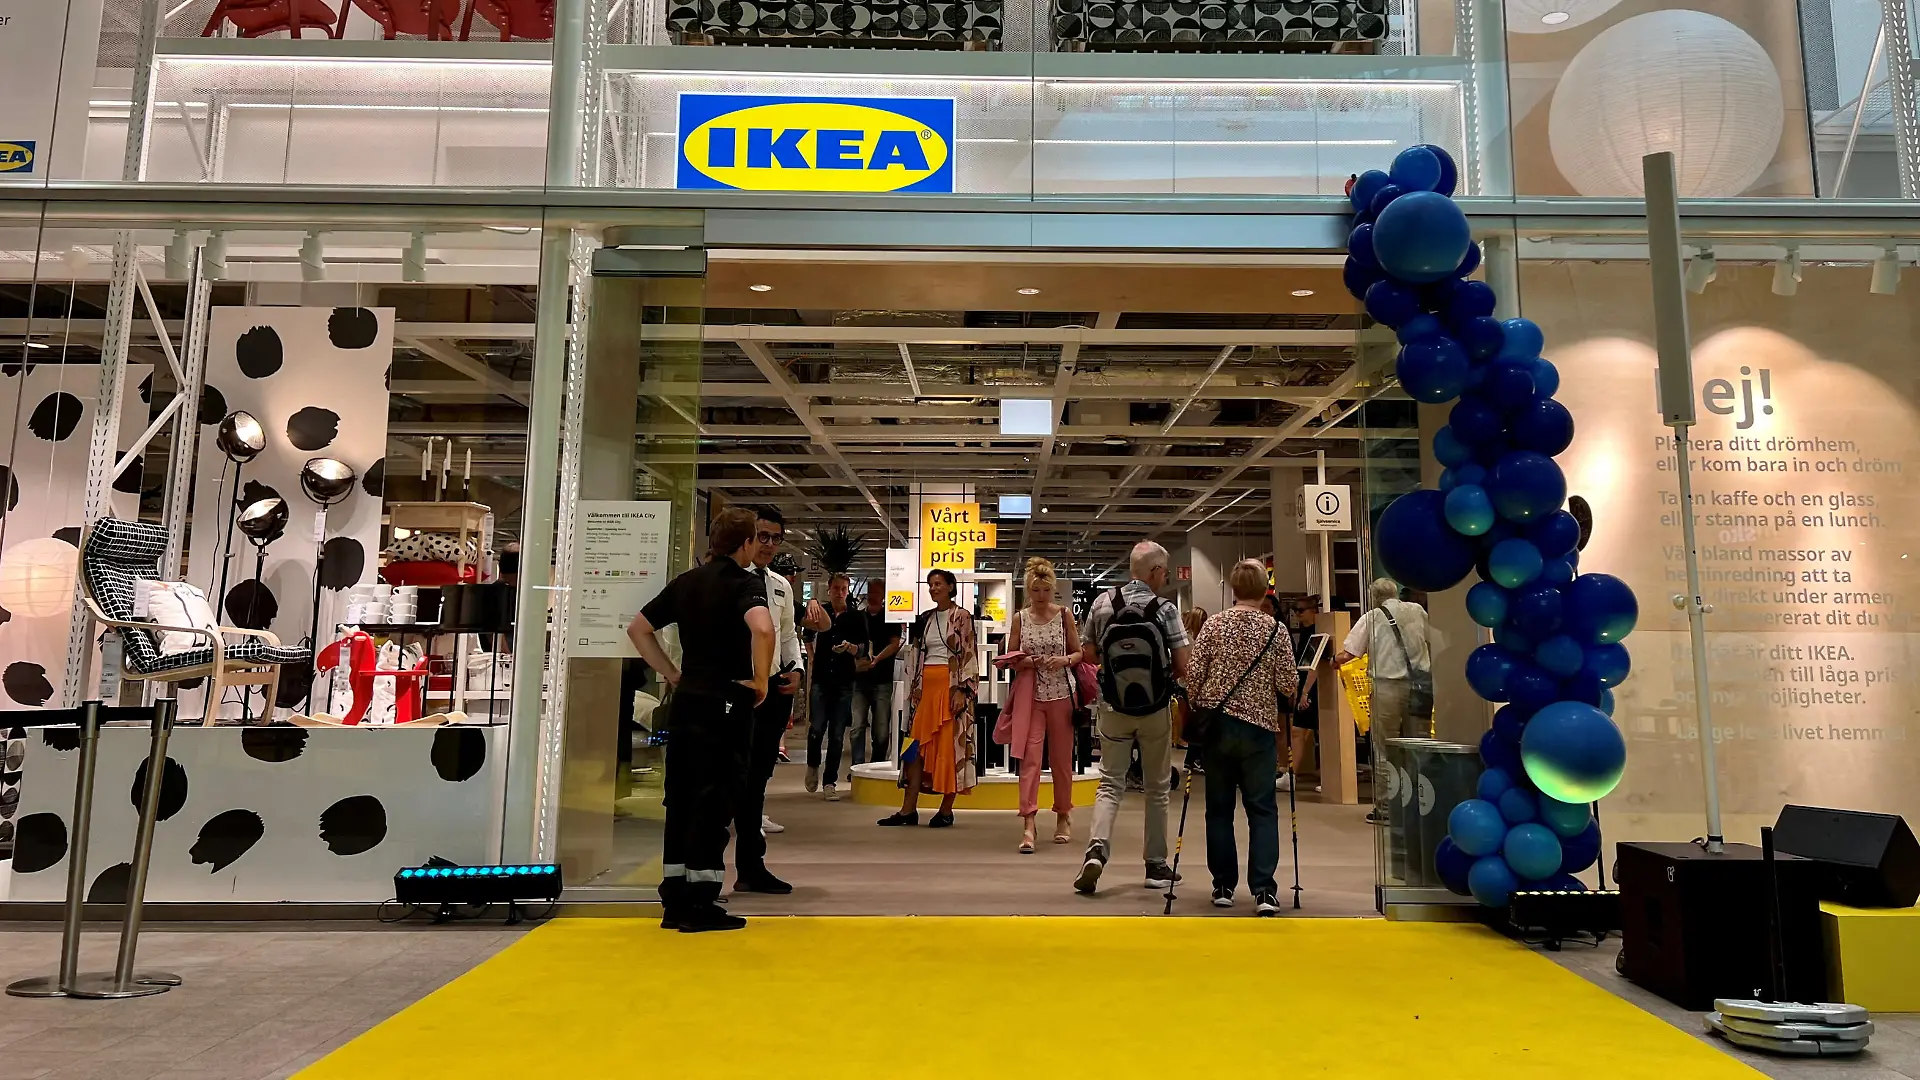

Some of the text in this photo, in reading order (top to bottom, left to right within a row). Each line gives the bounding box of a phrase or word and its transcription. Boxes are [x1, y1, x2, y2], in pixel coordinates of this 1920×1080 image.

[1655, 366, 1774, 429] ej!
[1728, 436, 1761, 451] ditt
[1766, 436, 1861, 454] drömhem,
[1656, 456, 1696, 471] ellr
[1701, 456, 1741, 472] kom
[1747, 457, 1788, 472] bara
[1793, 457, 1810, 472] in
[1814, 457, 1847, 472] och
[1658, 490, 1678, 505] Ta
[1711, 490, 1758, 506] kaffe
[1763, 490, 1796, 506] och
[1800, 494, 1823, 506] en
[1828, 491, 1879, 510] glass,
[930, 507, 969, 523] Vårt
[1660, 510, 1886, 531] ellr stanna på en lunch.
[931, 527, 986, 546] lägsta
[931, 548, 964, 566] pris
[1702, 546, 1753, 560] bland
[1759, 549, 1825, 562] massor
[1831, 550, 1852, 562] av
[1801, 569, 1828, 582] att
[1834, 570, 1852, 582] ta
[889, 595, 908, 606] 79:-
[1773, 589, 1827, 604] under
[1826, 610, 1852, 625] dit
[1856, 610, 1880, 626] du
[1770, 644, 1803, 660] ditt
[1808, 645, 1855, 661] IKEA.
[1790, 666, 1814, 682] till
[1820, 664, 1859, 686] låga
[1782, 724, 1824, 740] livet
